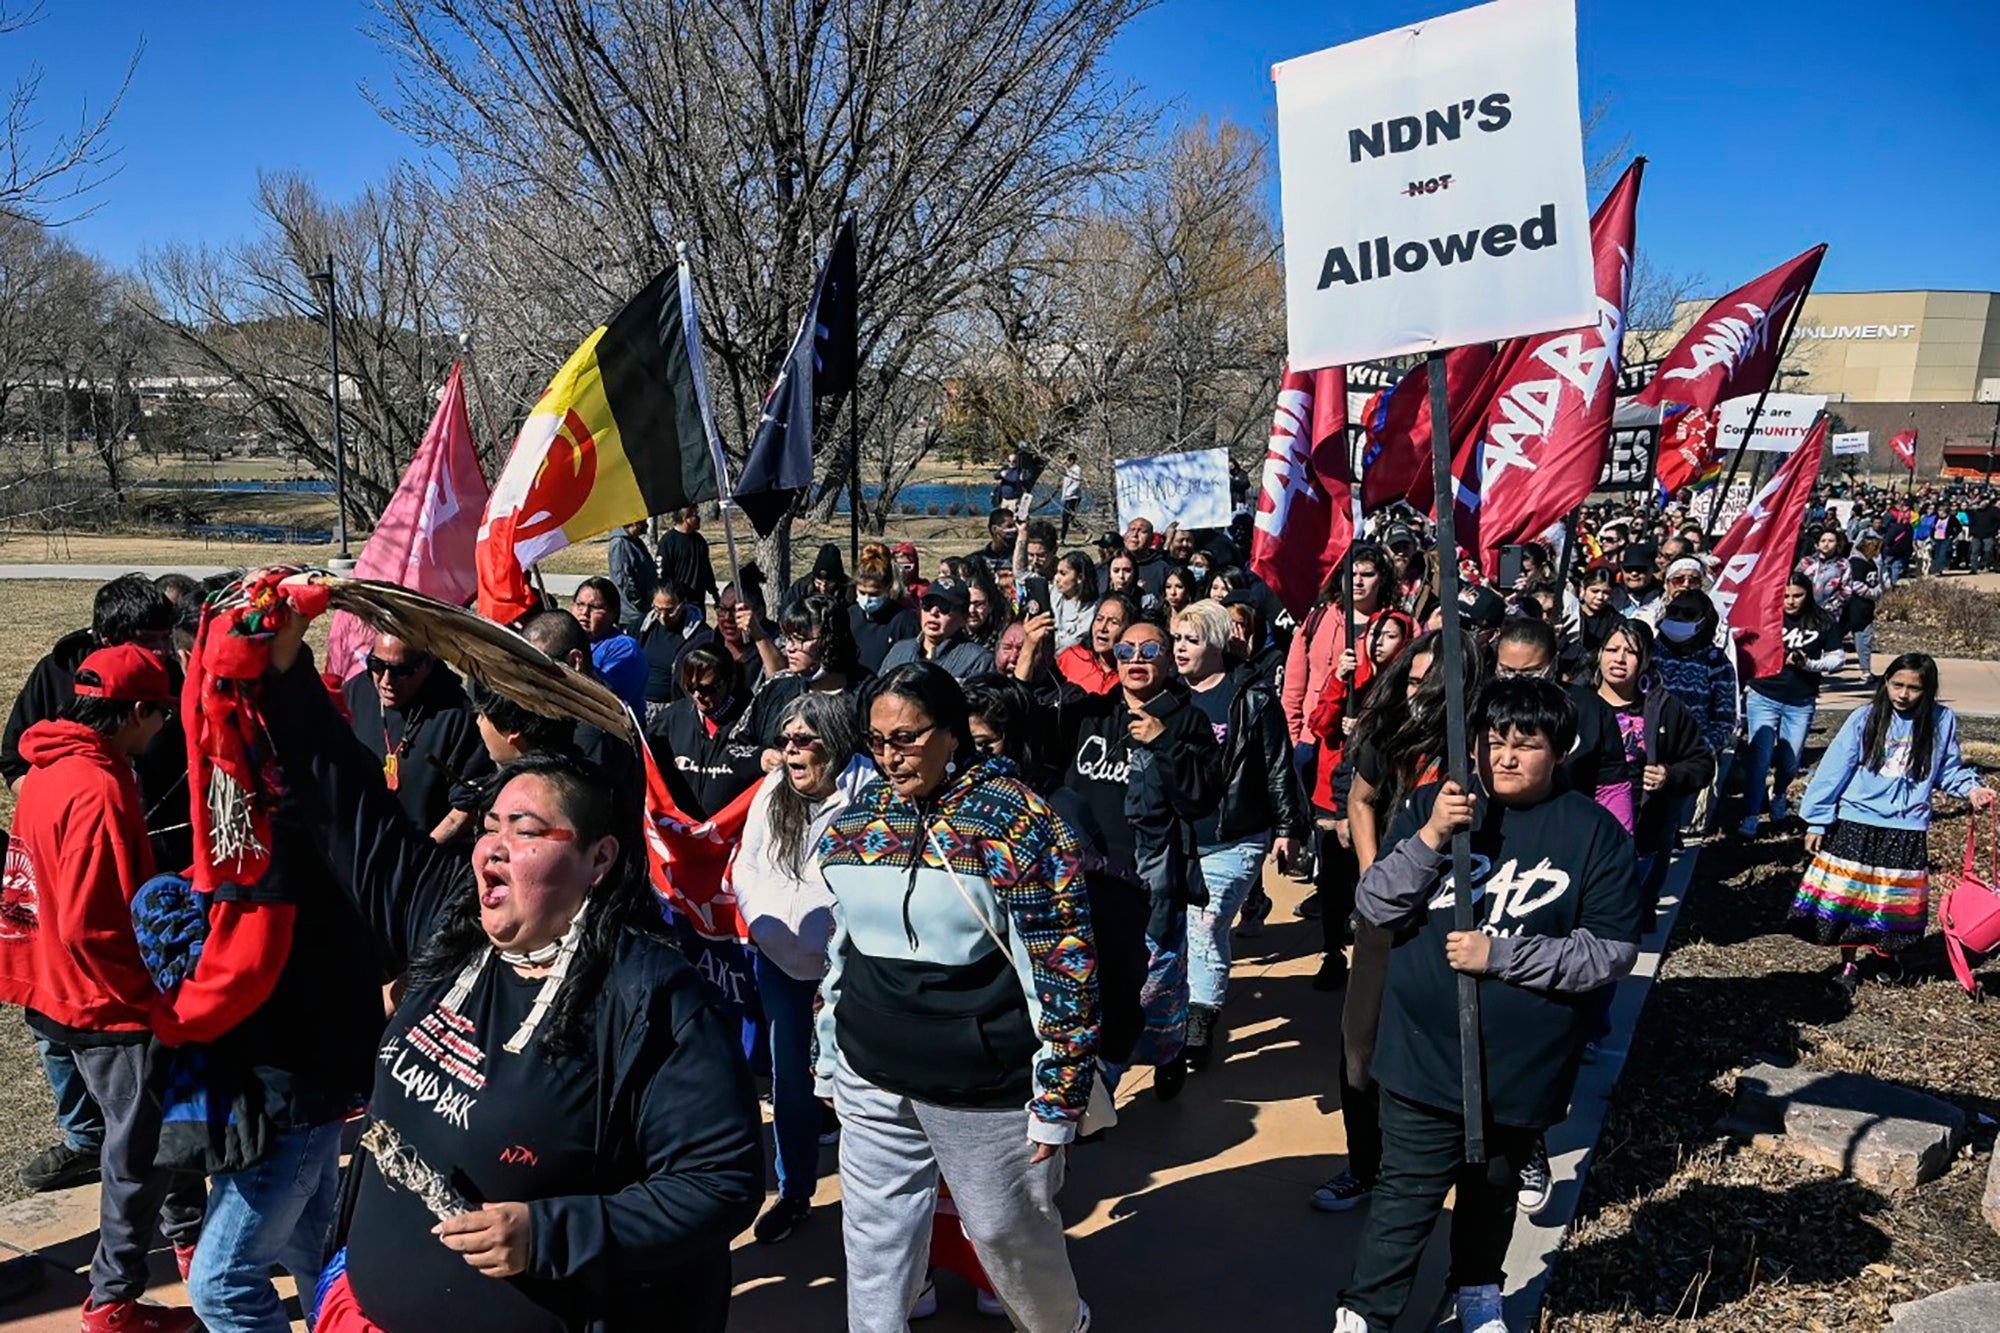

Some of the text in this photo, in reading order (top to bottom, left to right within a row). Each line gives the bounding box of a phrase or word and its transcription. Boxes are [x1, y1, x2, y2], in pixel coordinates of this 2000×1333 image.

[1348, 93, 1512, 163] NDN'S
[1406, 174, 1454, 197] NOT
[1317, 203, 1558, 290] Allowed
[1791, 325, 1915, 339] ONUMENT
[1770, 408, 1792, 418] are
[1077, 735, 1132, 784] Quee
[1427, 856, 1571, 925] BAD
[405, 1026, 445, 1062] WHITE
